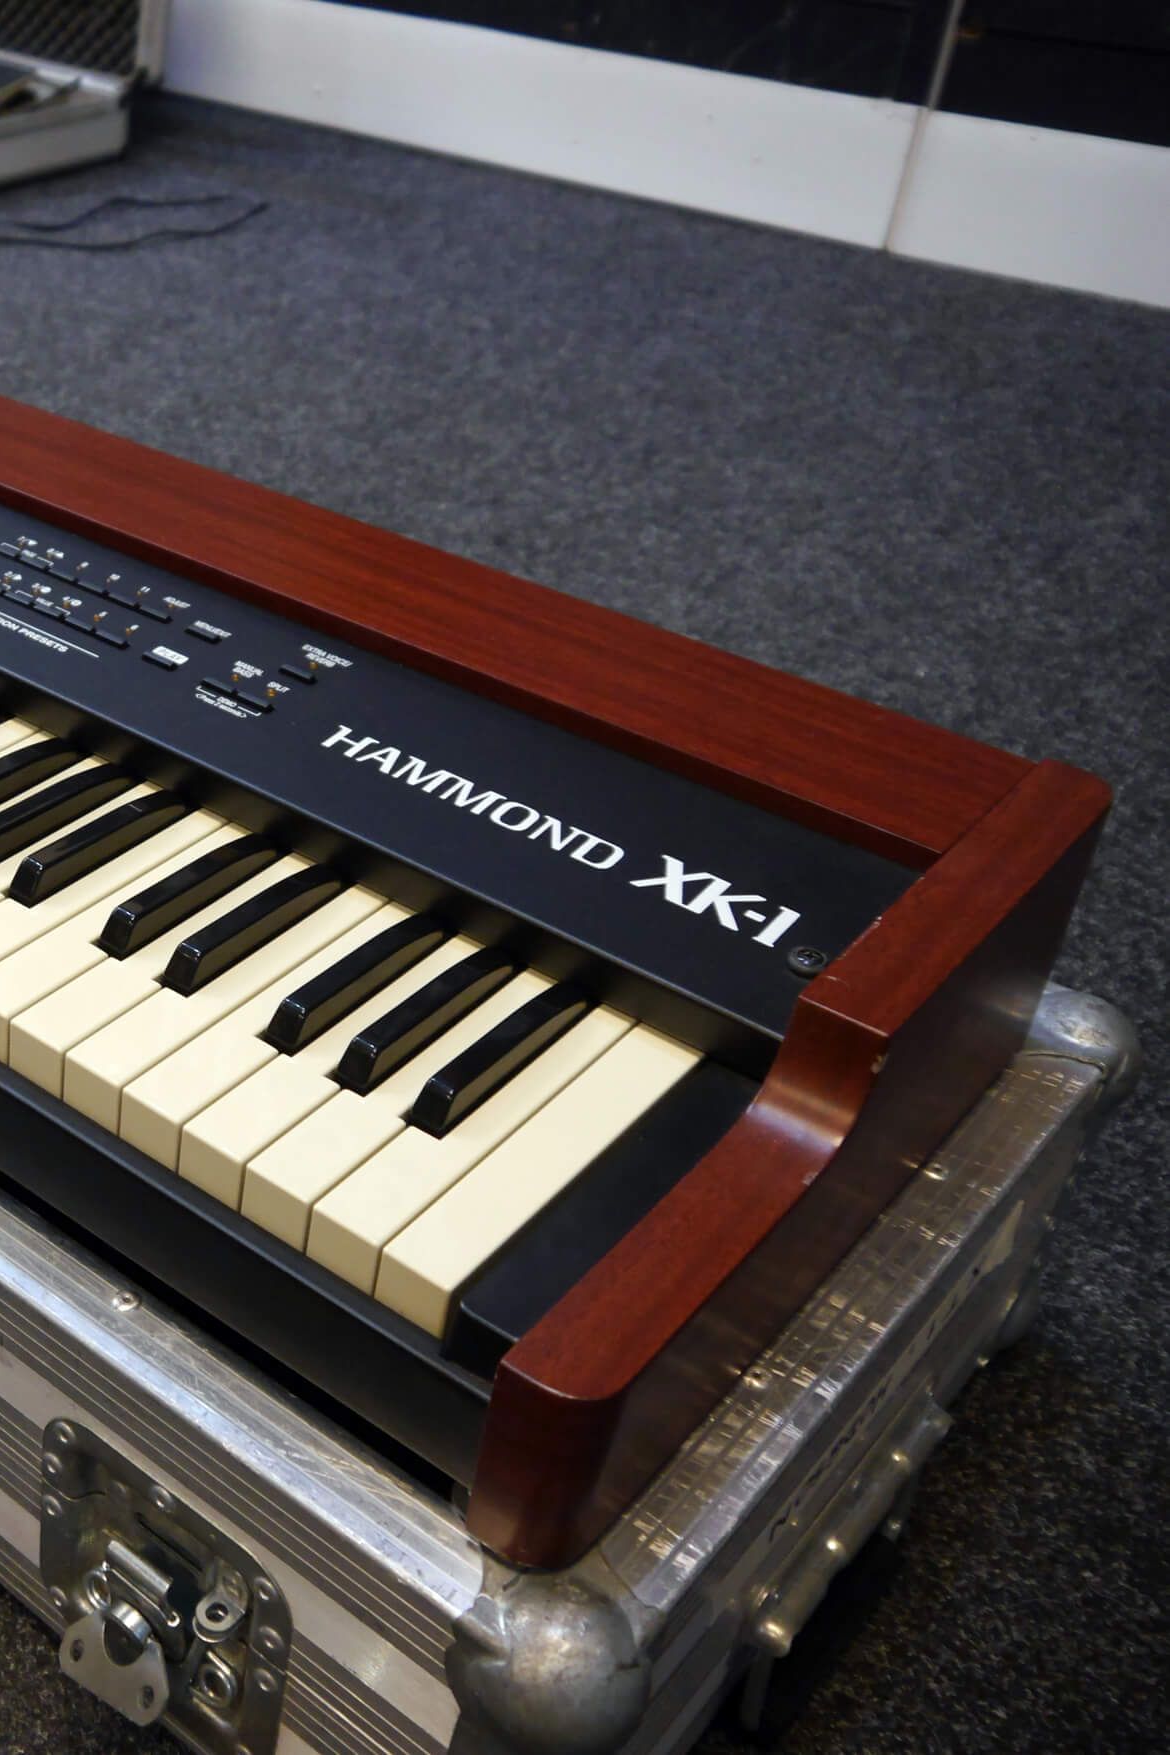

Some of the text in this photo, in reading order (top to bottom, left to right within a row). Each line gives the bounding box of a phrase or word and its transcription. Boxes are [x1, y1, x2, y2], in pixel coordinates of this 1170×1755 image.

[18, 626, 69, 653] PRESETS
[266, 681, 291, 694] SPLIT
[320, 724, 801, 948] HAMMOND XK-1
